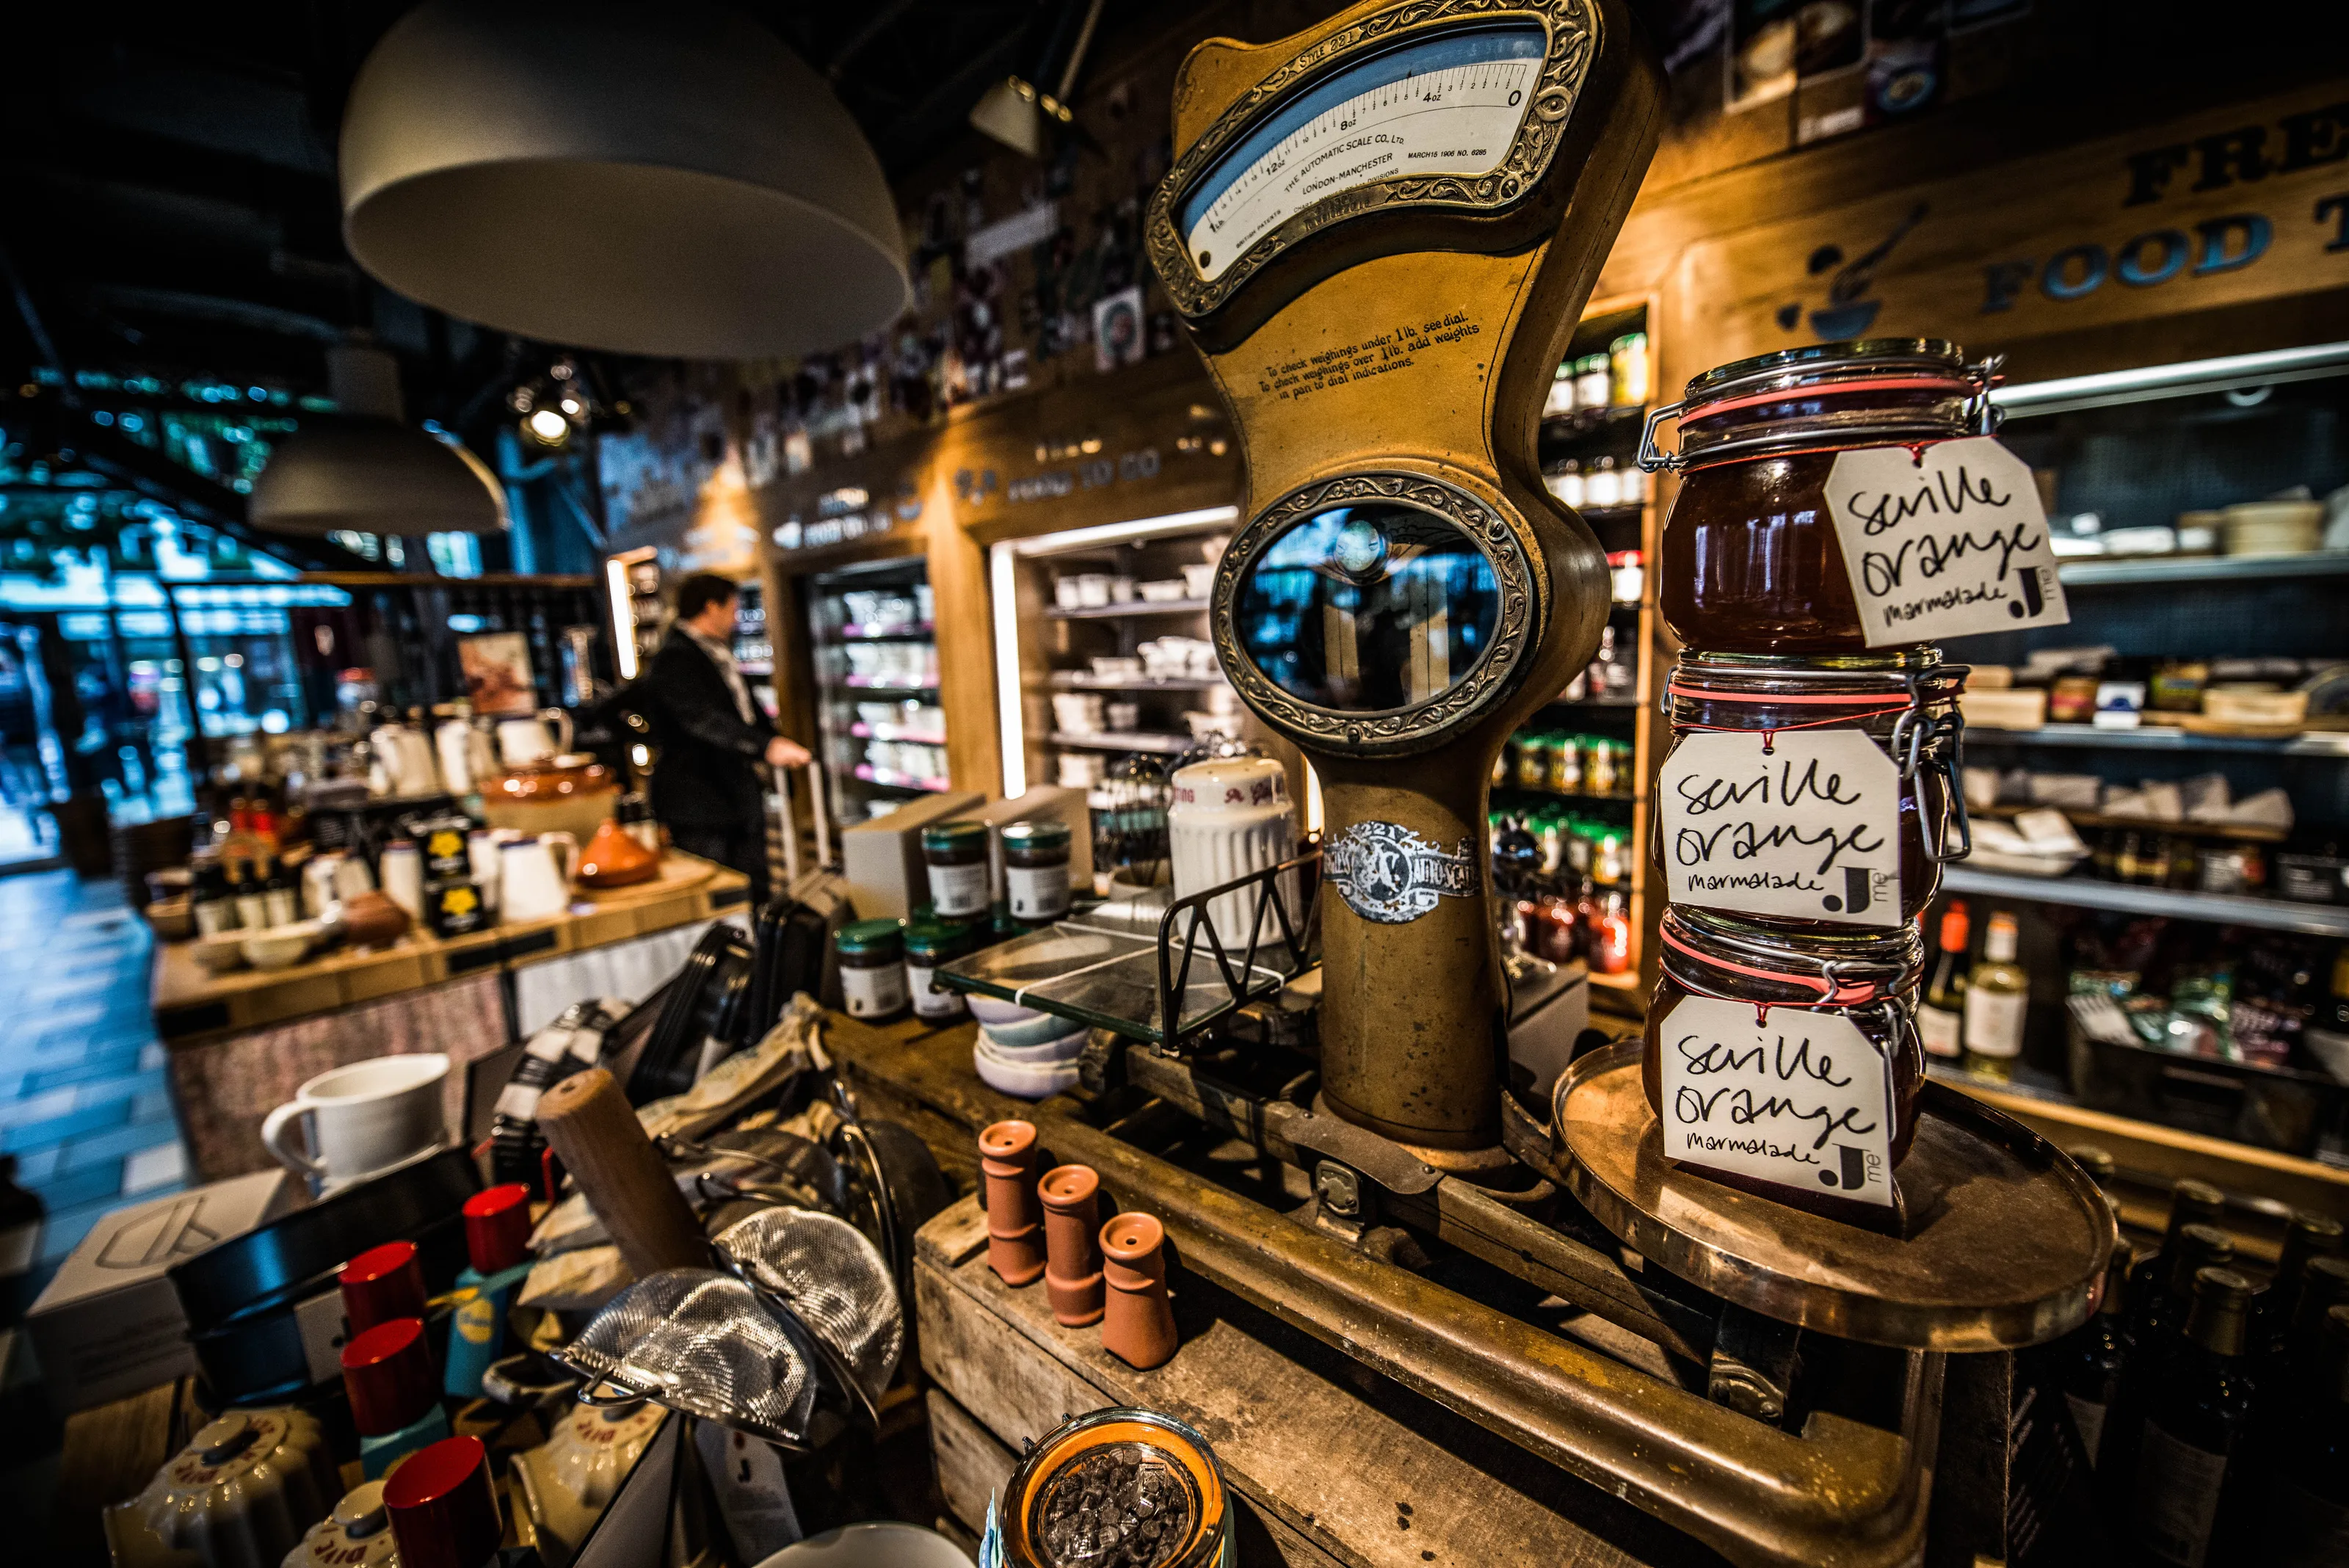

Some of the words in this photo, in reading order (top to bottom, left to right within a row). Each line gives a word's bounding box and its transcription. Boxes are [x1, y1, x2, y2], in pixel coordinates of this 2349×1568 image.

[1330, 32, 1353, 51] 221
[1508, 90, 1522, 106] 0
[1284, 174, 1299, 193] THE
[1301, 145, 1344, 177] AUTOMATIC
[1346, 136, 1373, 150] SCALE
[1257, 209, 1281, 231] PATENTS
[1980, 212, 2274, 315] FOOD
[1258, 380, 1271, 392] To
[1274, 374, 1300, 390] check
[1302, 360, 1350, 380] weighings
[1353, 353, 1374, 366] over
[1408, 335, 1431, 352] add
[1434, 324, 1480, 344] weights
[1266, 366, 1277, 377] To
[1281, 359, 1307, 374] check
[1310, 345, 1358, 365] weighings
[1362, 335, 1391, 351] under
[1423, 320, 1442, 333] see
[1443, 311, 1469, 327] dial.
[1279, 391, 1290, 400] in
[1293, 385, 1313, 400] pan
[1314, 380, 1324, 390] to
[1328, 374, 1349, 387] dial
[1351, 357, 1414, 381] indications.
[1862, 523, 2040, 598] orange
[1883, 581, 2008, 628] marmalade
[1676, 821, 1885, 875] orange
[1688, 871, 1825, 892] marmalade
[1675, 1085, 1876, 1150] orange
[1686, 1132, 1820, 1164] marmalade
